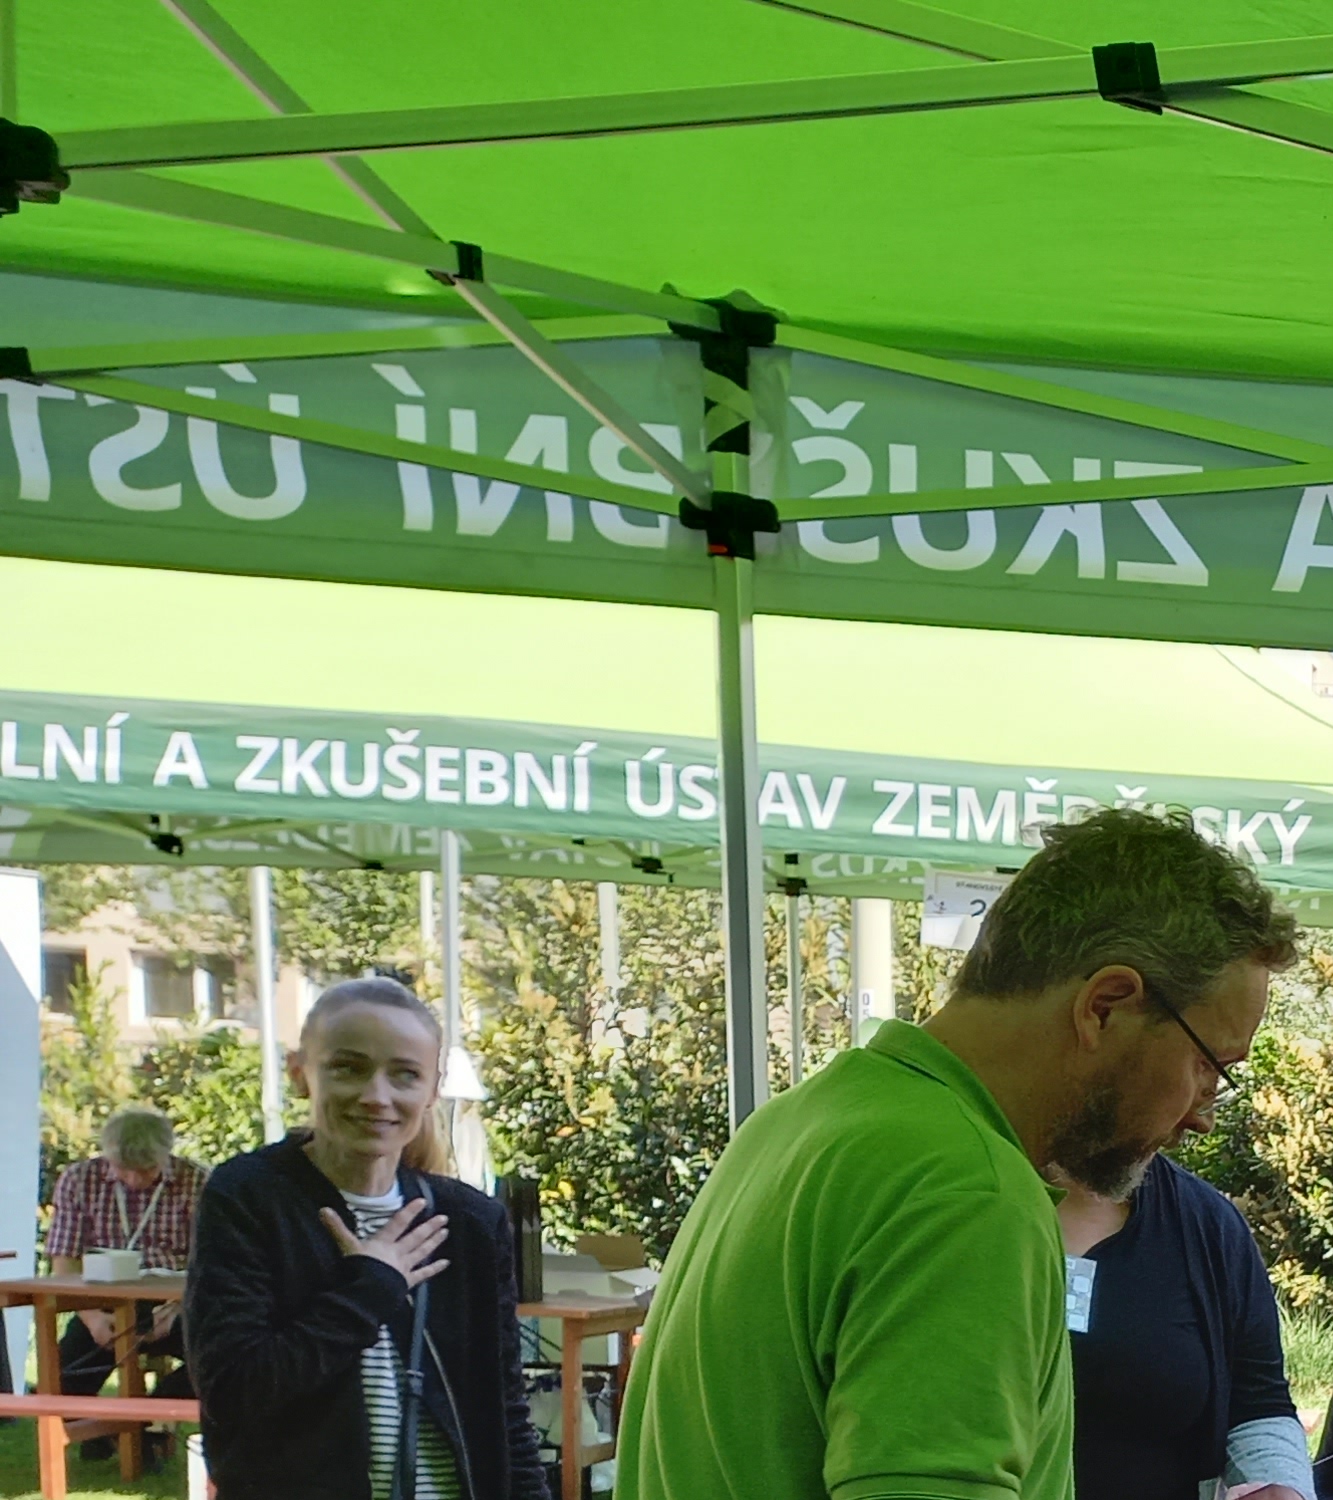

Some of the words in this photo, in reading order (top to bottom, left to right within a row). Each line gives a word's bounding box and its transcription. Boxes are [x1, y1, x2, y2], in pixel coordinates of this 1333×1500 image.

[153, 730, 209, 790] A
[234, 727, 598, 813] ZKUŠEBNÍ
[626, 746, 846, 831] ÚSAV
